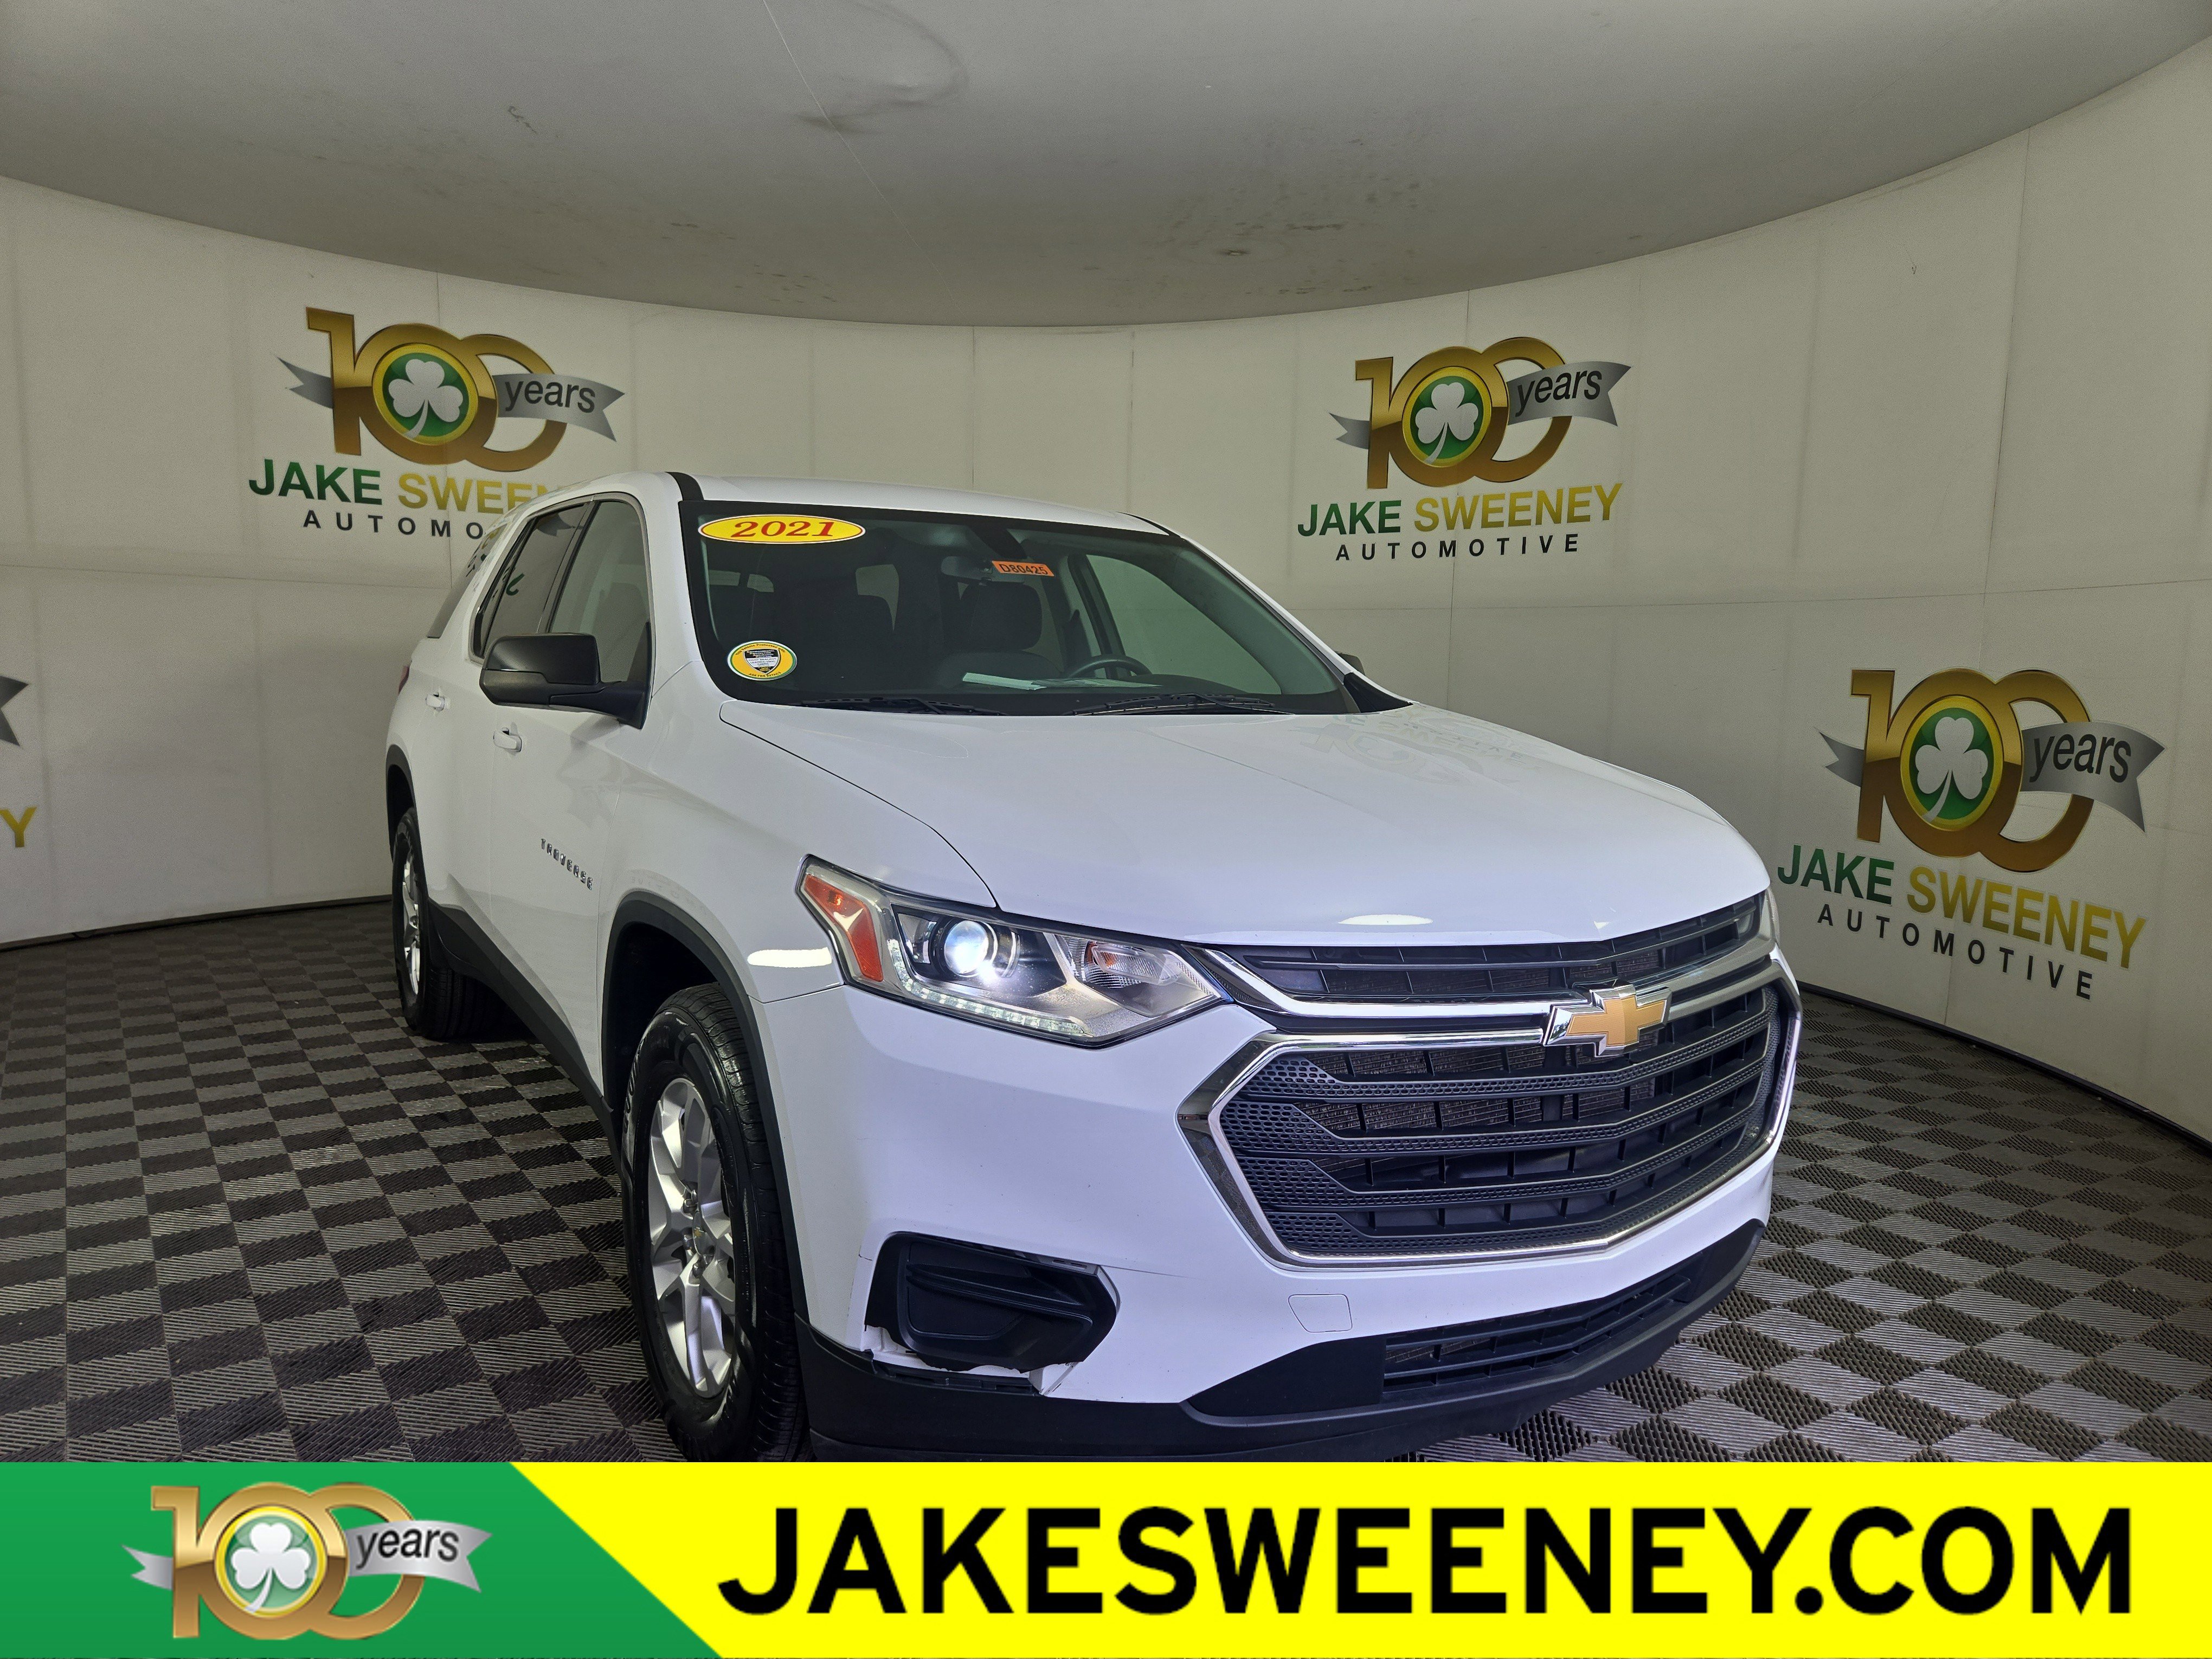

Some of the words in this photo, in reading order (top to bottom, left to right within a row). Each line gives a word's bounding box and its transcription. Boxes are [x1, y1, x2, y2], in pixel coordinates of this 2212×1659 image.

[306, 307, 567, 472] 100
[504, 381, 596, 413] years
[1355, 337, 1573, 489] 100
[1515, 369, 1602, 417] years
[249, 459, 383, 506] JAKE
[731, 521, 835, 537] 2021
[1298, 500, 1401, 536] JAKE
[1414, 483, 1623, 532] SWEENEY
[999, 563, 1049, 575] D80425
[1336, 534, 1578, 561] AUTOMOTIVE
[1851, 668, 2094, 872] 100
[2029, 734, 2131, 783] years
[541, 838, 593, 890] TRAVERSE
[1778, 845, 1894, 905] JAKE
[1907, 867, 2146, 969] SWEENEY
[1817, 904, 2092, 1000] AUTOMOTIVE
